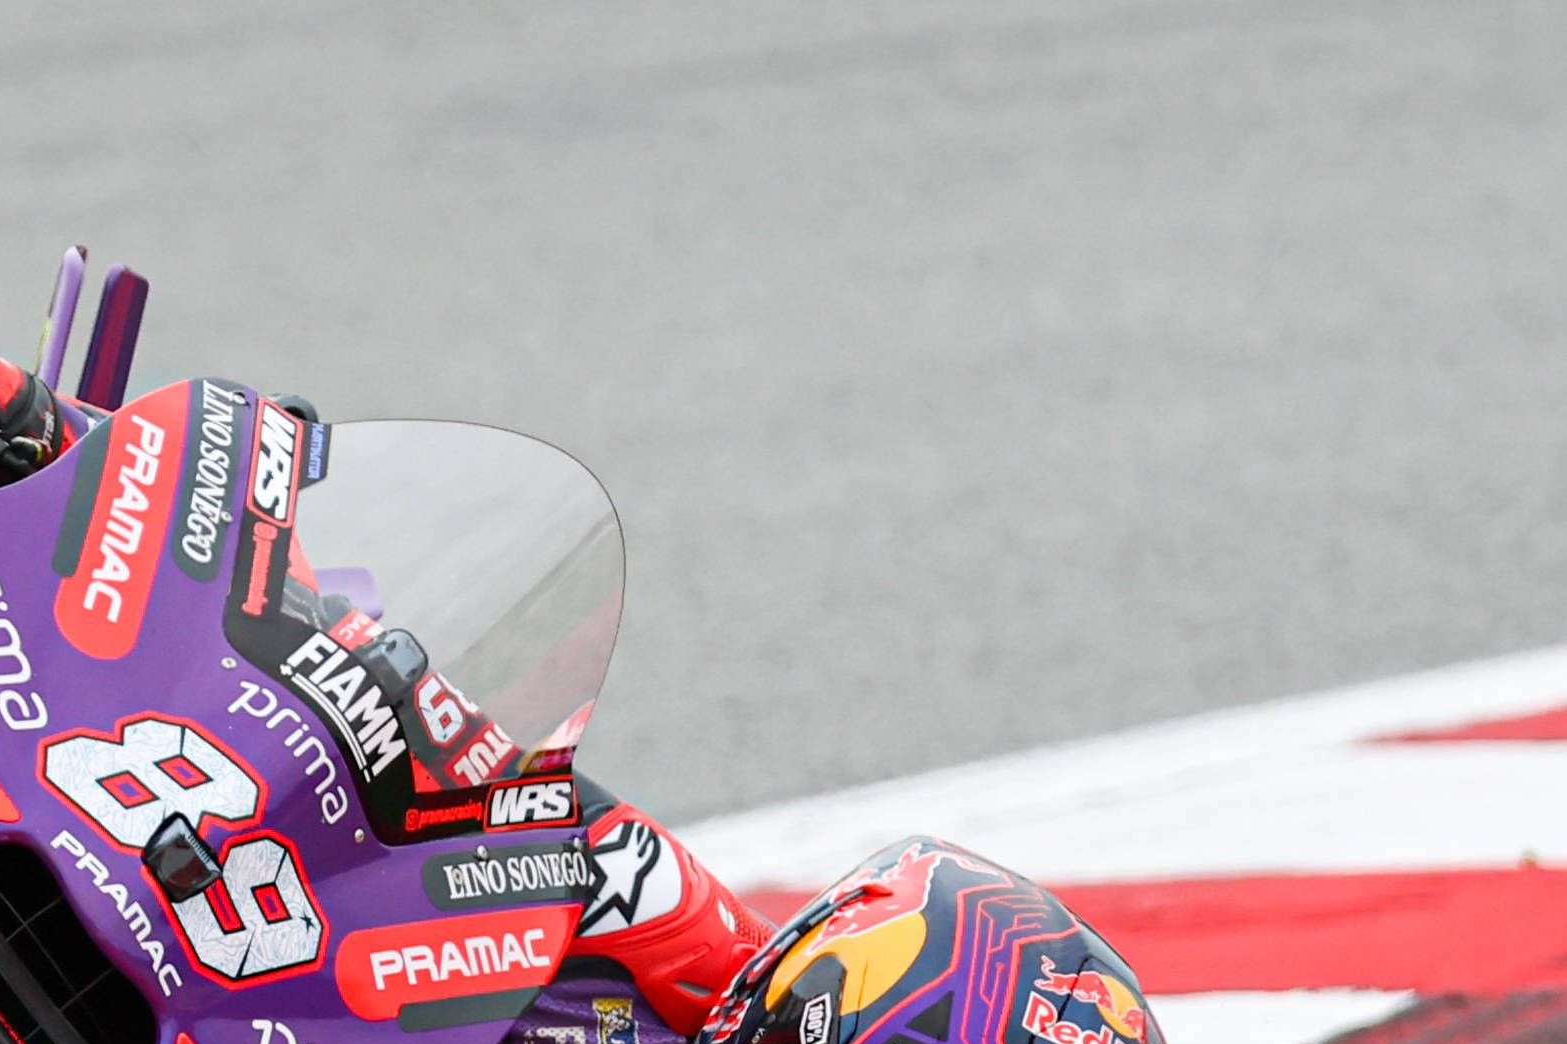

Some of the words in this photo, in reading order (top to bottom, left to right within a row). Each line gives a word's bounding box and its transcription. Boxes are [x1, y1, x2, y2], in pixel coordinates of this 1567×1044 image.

[83, 414, 165, 623] PRAMAC
[253, 404, 296, 520] WRS
[228, 681, 348, 824] prima
[286, 631, 408, 777] FIAMM
[453, 722, 515, 786] TUL
[36, 711, 331, 990] 89
[490, 782, 572, 826] WRS
[50, 830, 182, 997] PRAMAC
[443, 860, 507, 900] LINO
[506, 852, 587, 892] SONEGO
[370, 929, 551, 990] PRAMAC
[806, 1003, 824, 1043] 100%
